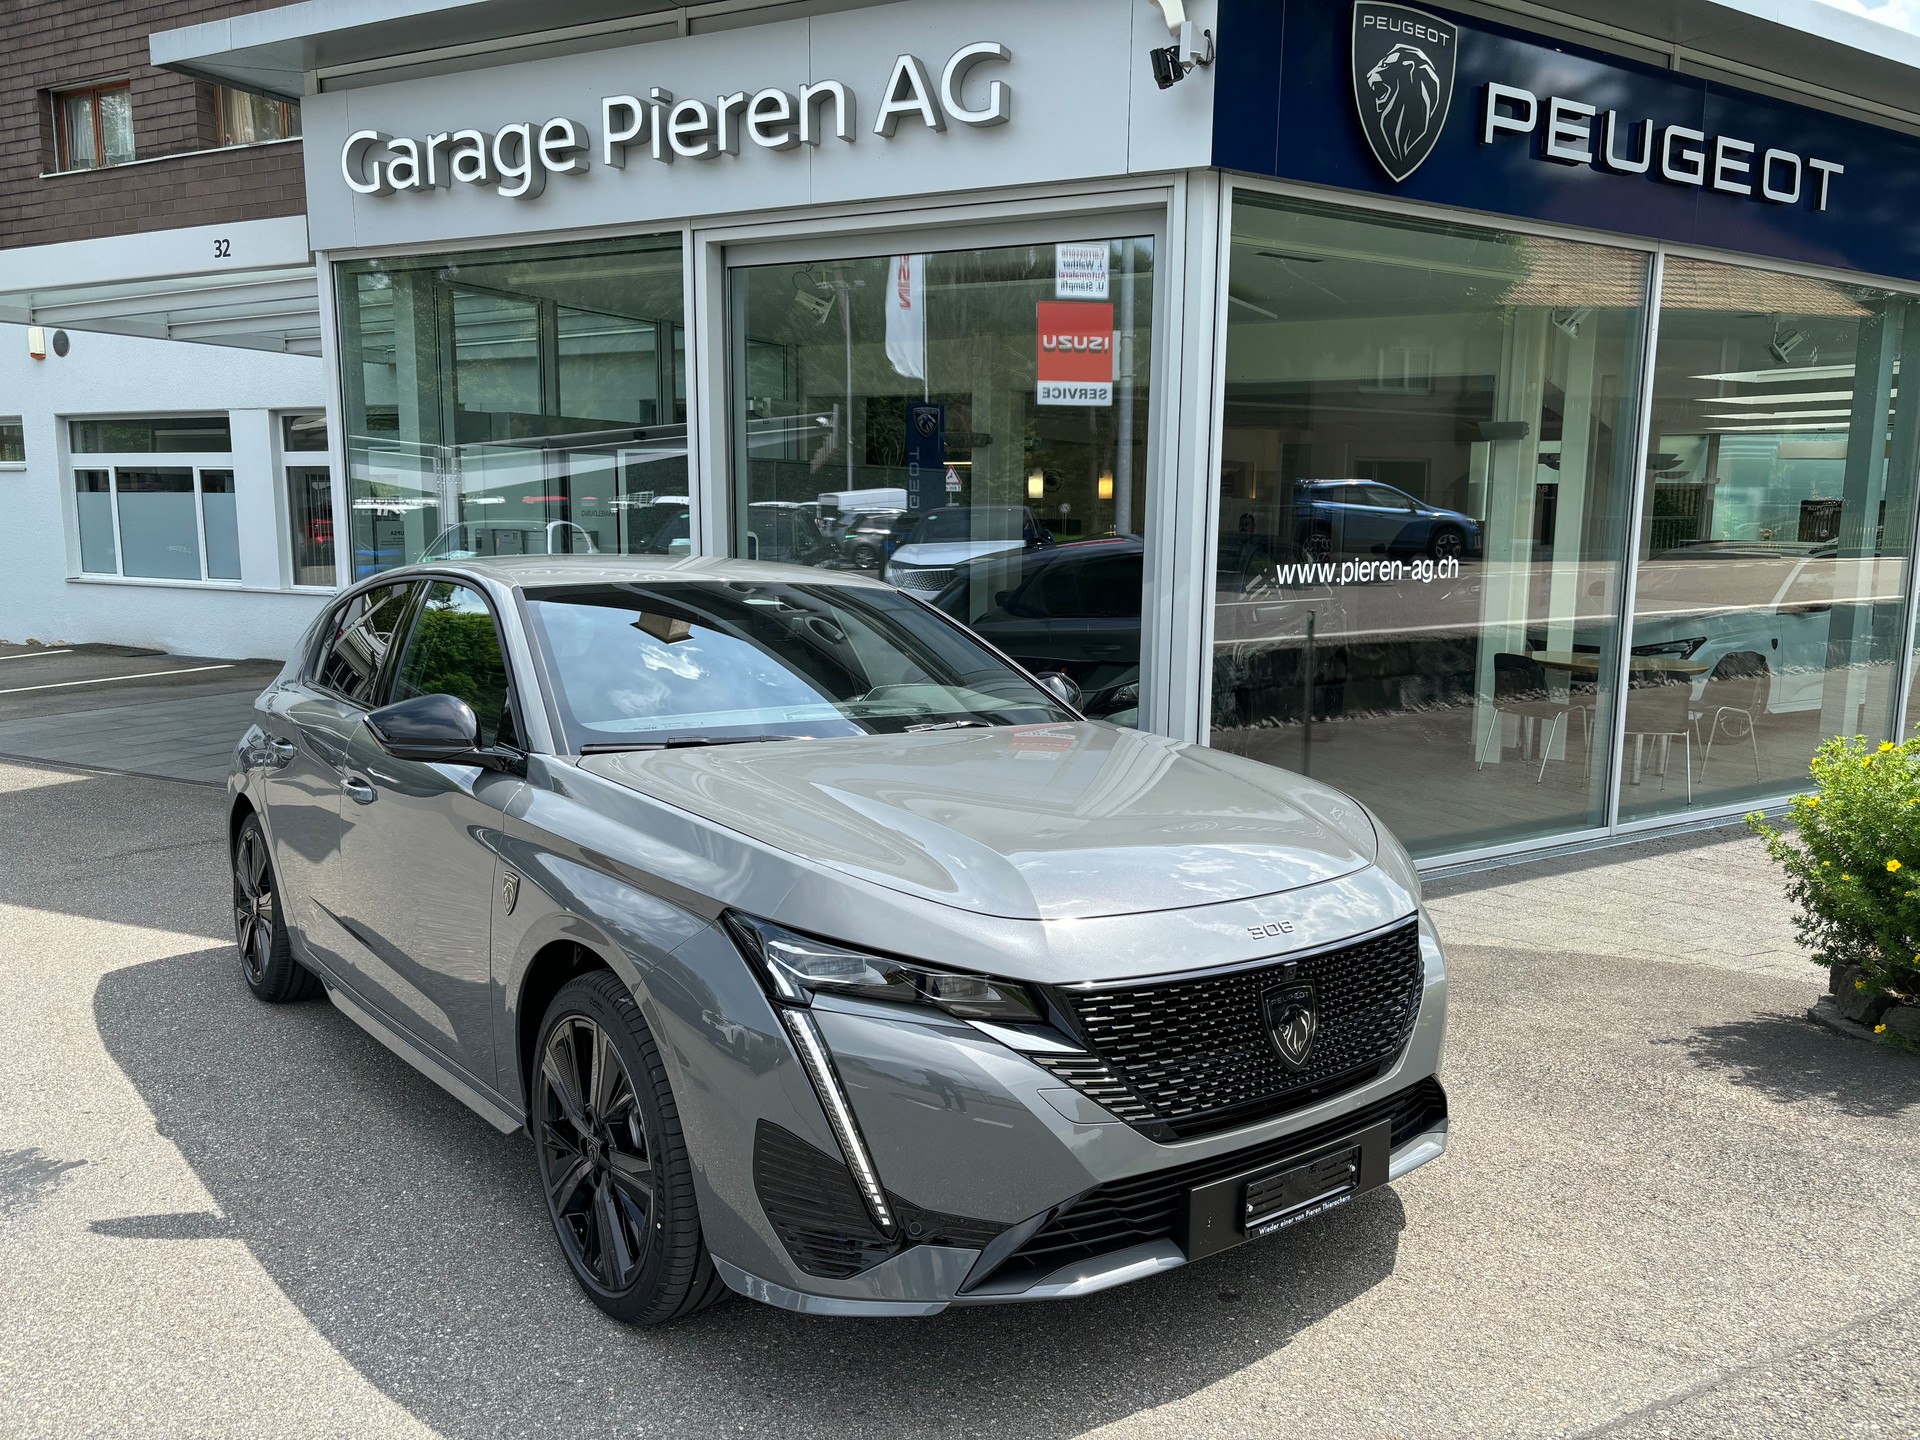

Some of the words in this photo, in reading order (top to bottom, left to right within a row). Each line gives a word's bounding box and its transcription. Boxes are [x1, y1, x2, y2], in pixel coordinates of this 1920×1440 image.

[1363, 14, 1450, 47] PEUGEOT
[341, 116, 589, 200] Garage
[603, 78, 857, 169] Pieren
[873, 40, 1012, 138] AG
[1483, 82, 1845, 212] PEUGEOT
[213, 238, 231, 259] 32
[1276, 555, 1459, 586] www.pieren-ag.ch
[1247, 919, 1295, 941] 308
[1258, 1223, 1279, 1235] Wieder
[1280, 1217, 1294, 1227] einer
[1295, 1212, 1305, 1221] von
[1305, 1206, 1321, 1217] Pieren
